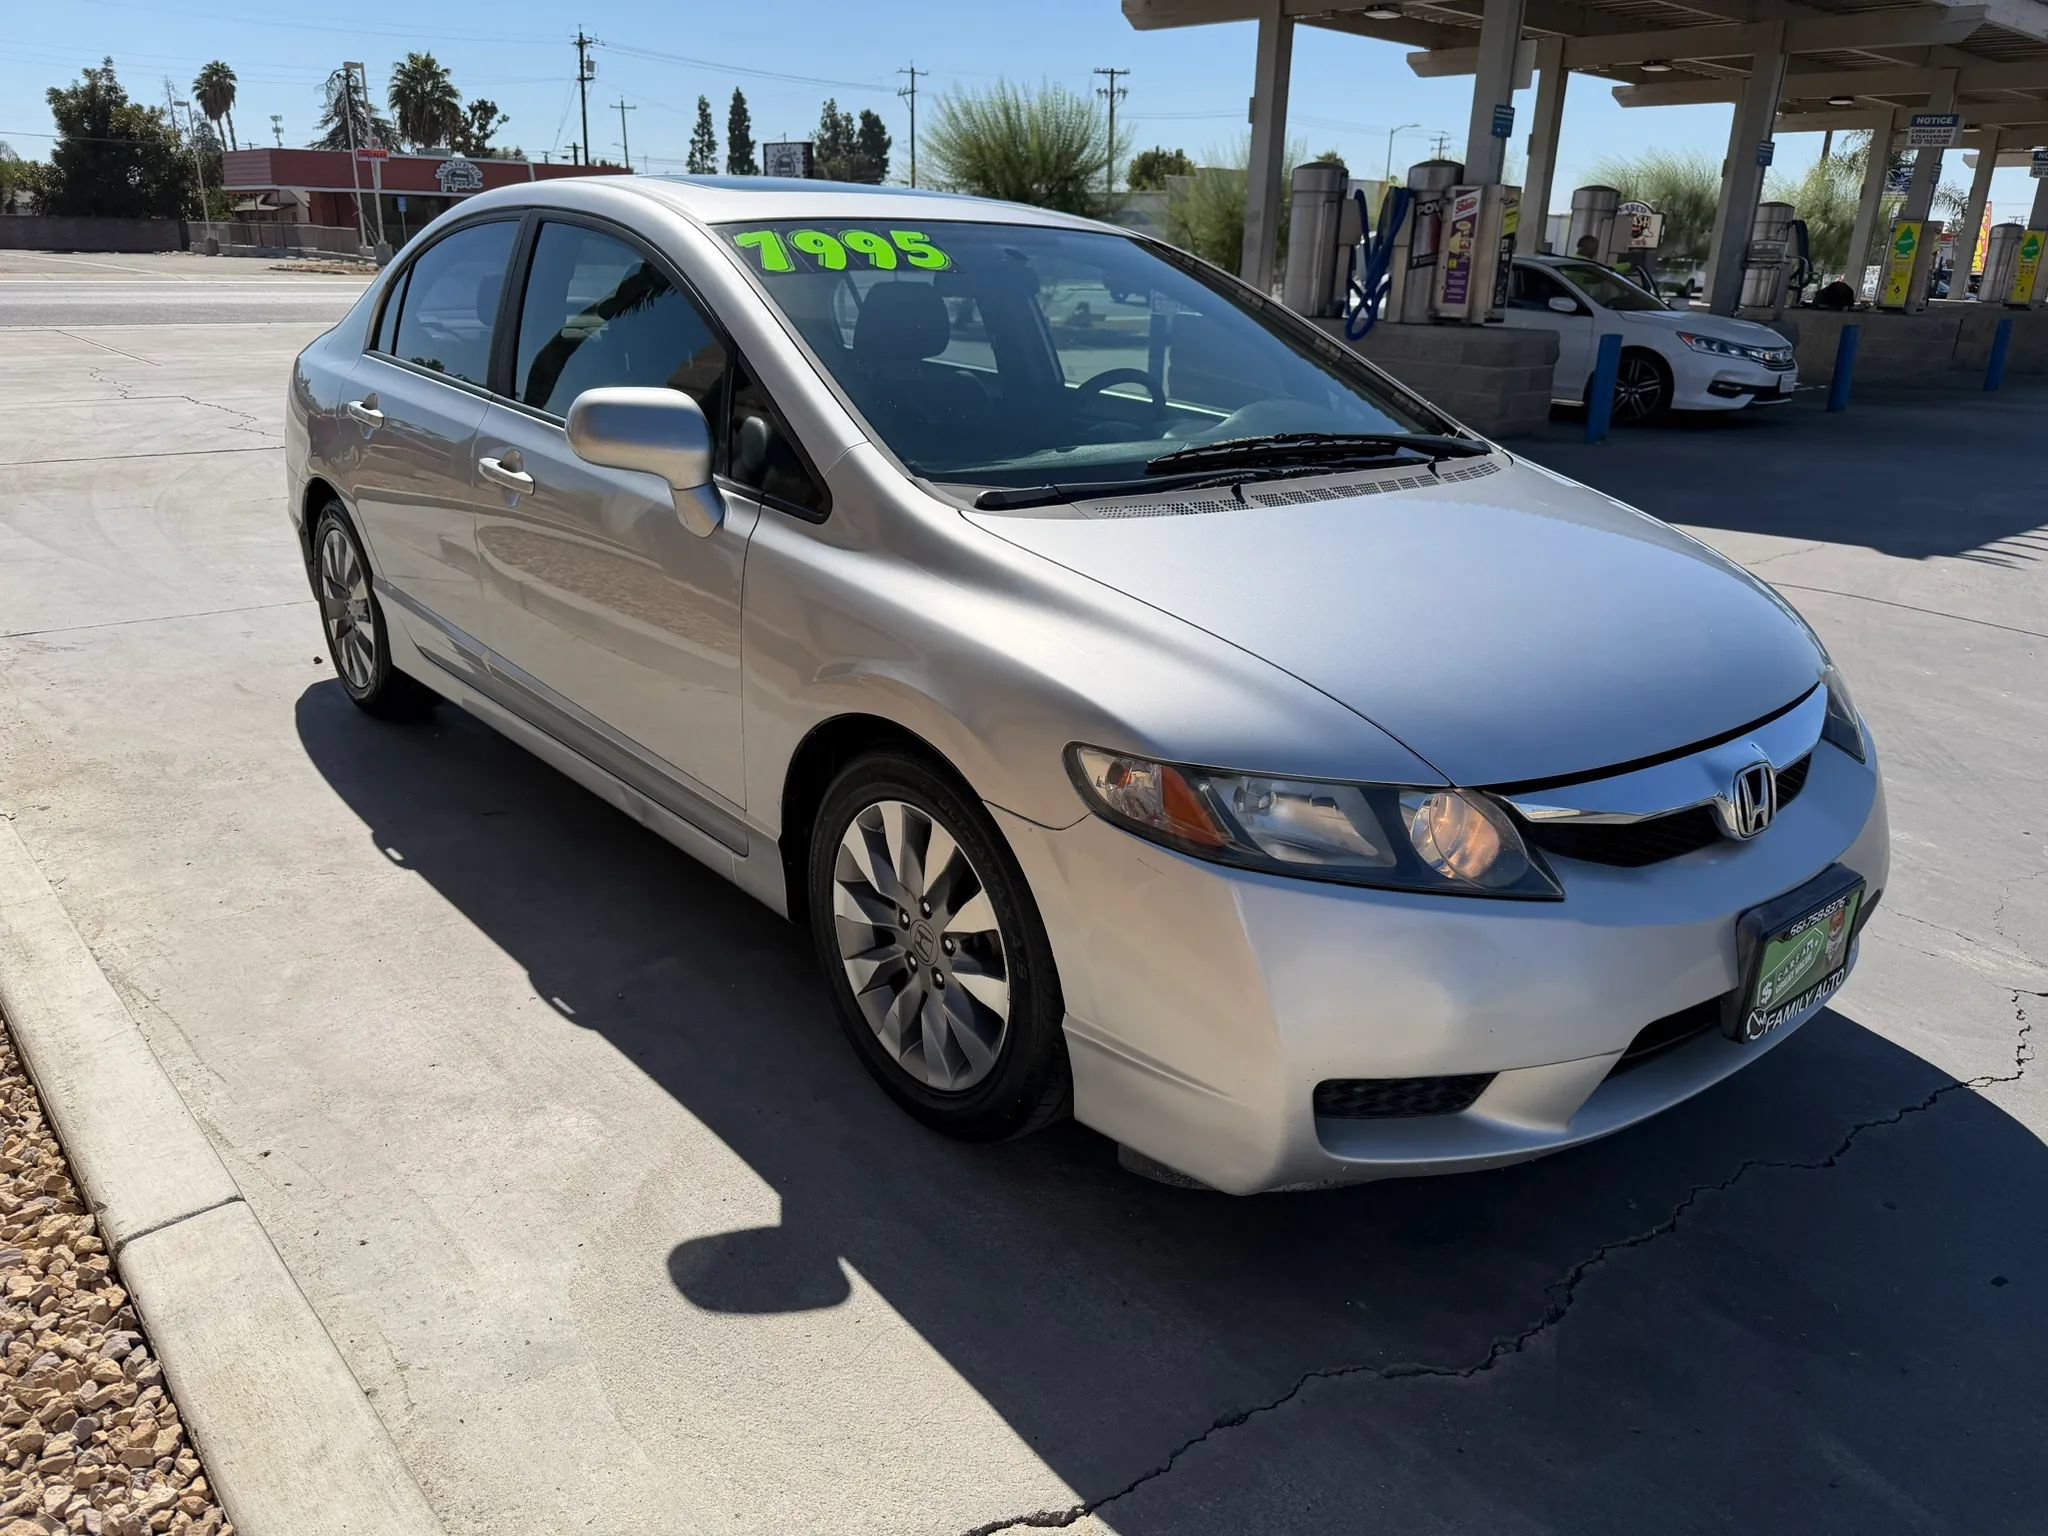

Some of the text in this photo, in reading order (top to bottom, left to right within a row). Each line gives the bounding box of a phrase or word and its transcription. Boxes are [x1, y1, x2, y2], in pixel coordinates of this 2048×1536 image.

[1916, 116, 1953, 125] NOTICE
[1632, 214, 1651, 228] ASH
[734, 229, 952, 272] 7995
[1790, 895, 1847, 936] 661-758-8376
[1764, 967, 1845, 1034] FAMILY AUTO
